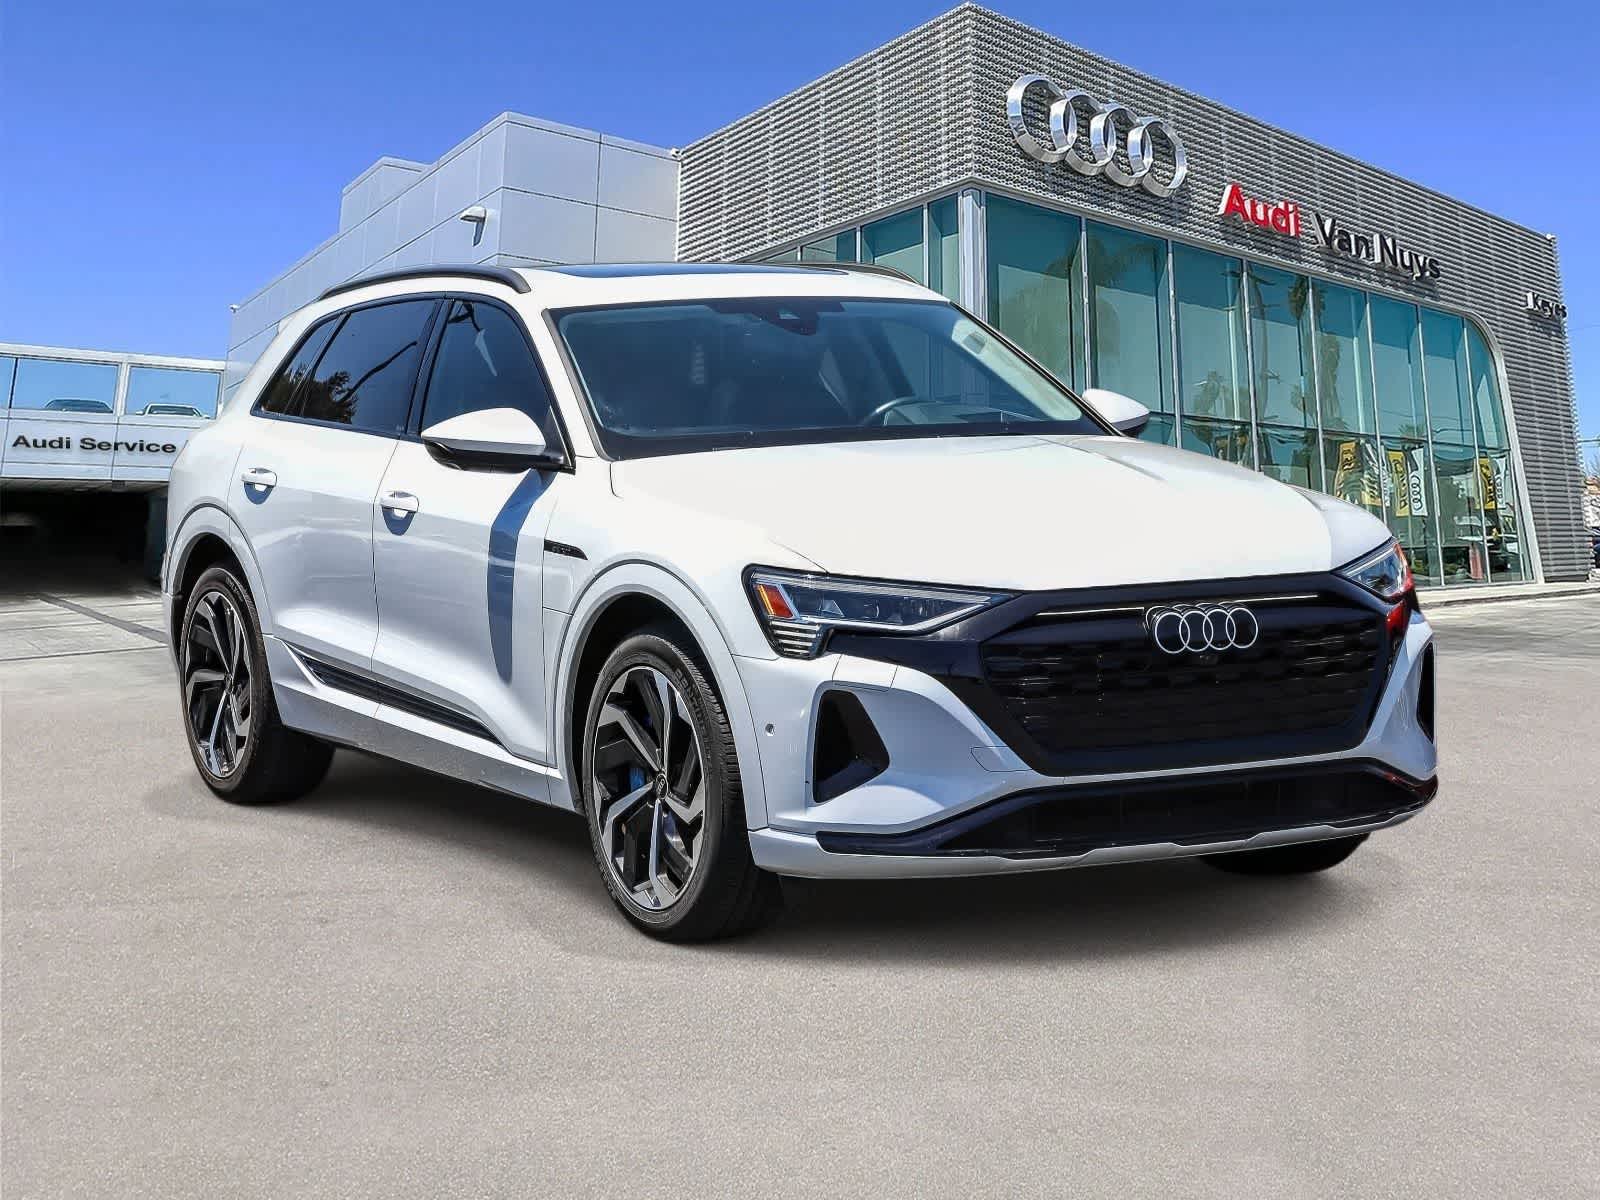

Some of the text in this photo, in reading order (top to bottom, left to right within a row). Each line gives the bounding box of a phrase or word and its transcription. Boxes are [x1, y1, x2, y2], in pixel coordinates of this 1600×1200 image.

[1218, 182, 1441, 280] Audi Van Nuys
[12, 435, 177, 453] Audi Service
